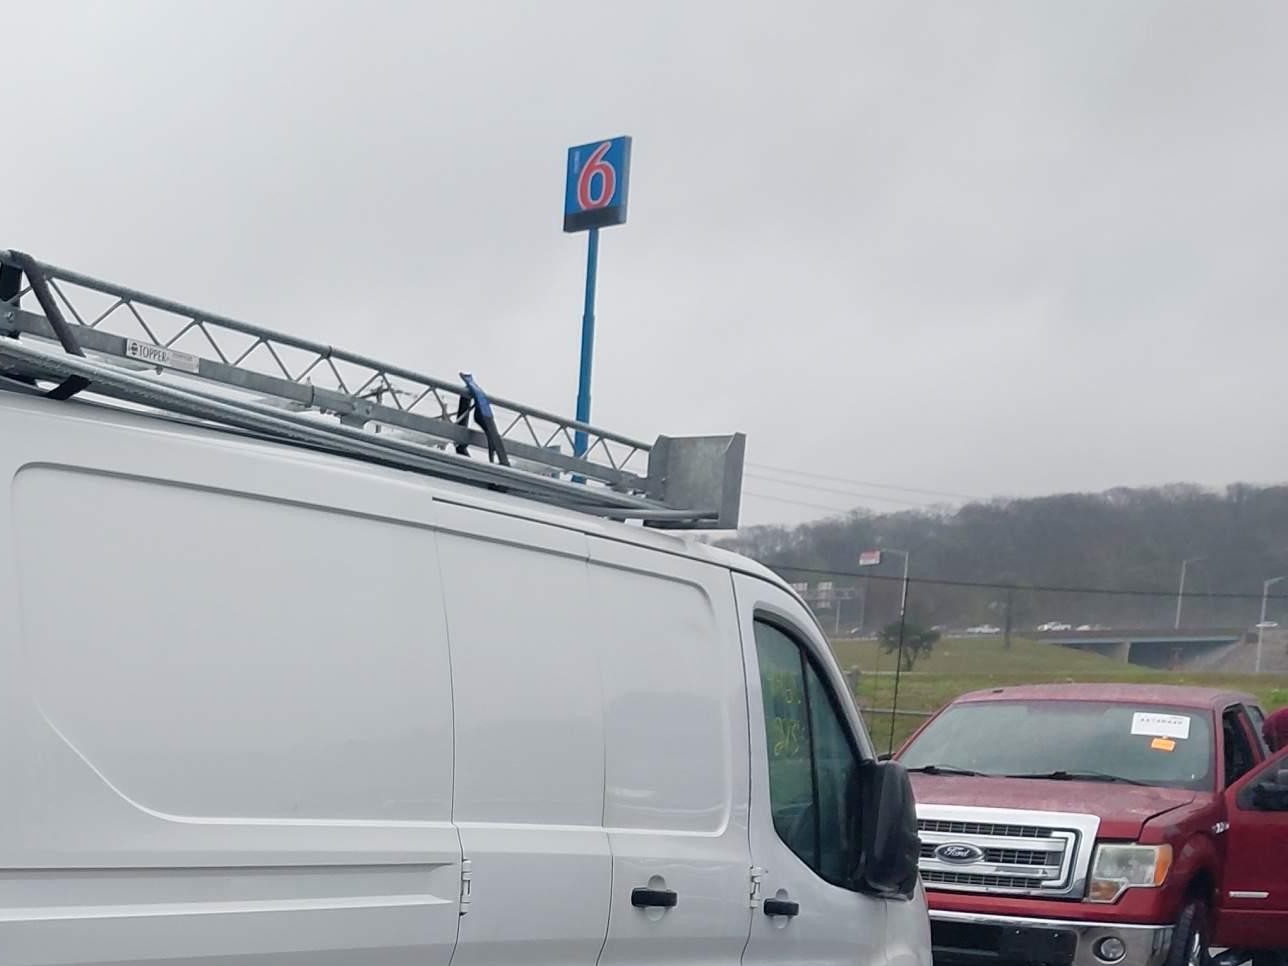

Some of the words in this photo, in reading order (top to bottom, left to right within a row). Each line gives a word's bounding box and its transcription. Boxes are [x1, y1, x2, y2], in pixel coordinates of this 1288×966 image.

[577, 141, 616, 210] 6
[139, 345, 167, 362] TOPPER
[943, 846, 970, 857] Ford
